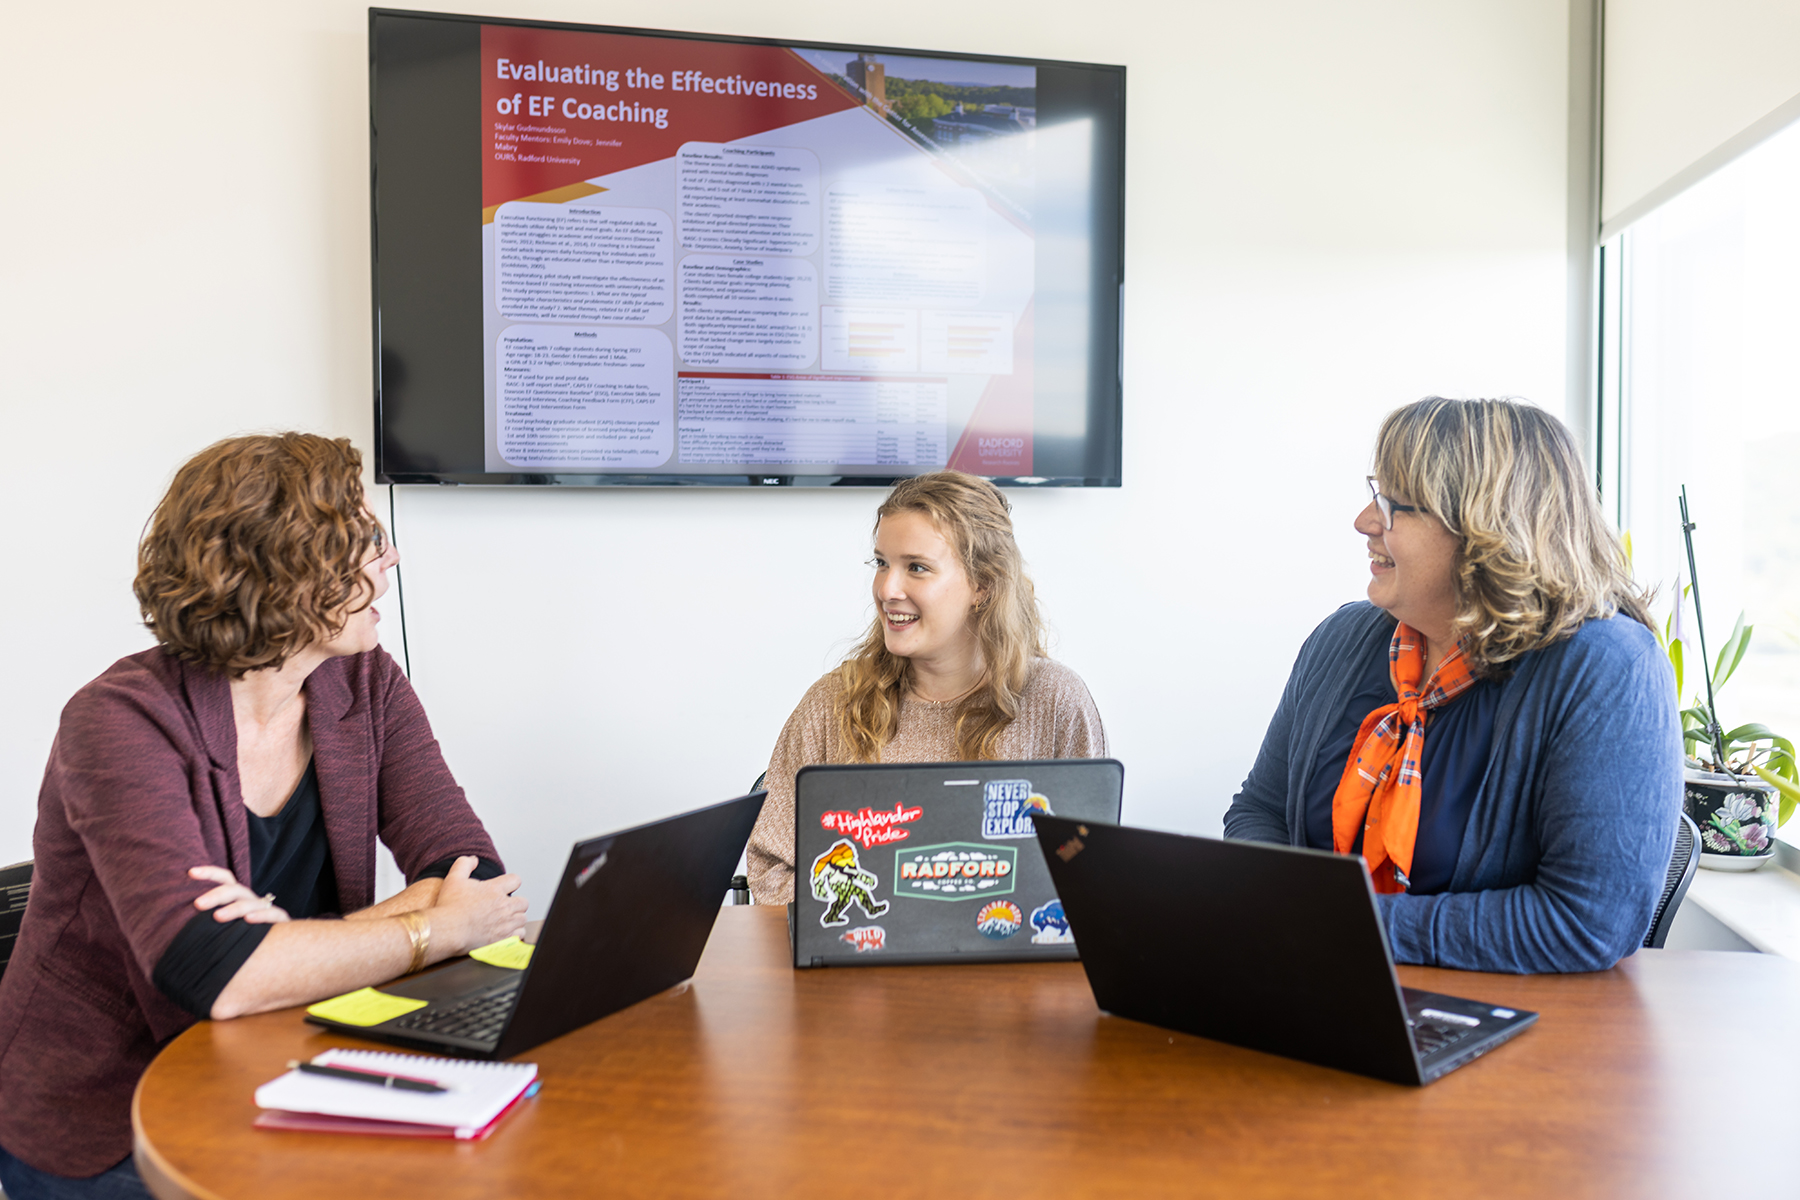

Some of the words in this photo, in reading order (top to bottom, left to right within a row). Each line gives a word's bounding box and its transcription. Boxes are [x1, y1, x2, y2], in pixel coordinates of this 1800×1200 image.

[497, 58, 620, 92] Evaluating
[626, 67, 664, 90] the
[671, 70, 818, 100] Effectiveness
[496, 93, 522, 116] of
[528, 95, 555, 116] EF
[562, 97, 669, 130] Coaching
[858, 86, 872, 99] with
[872, 96, 883, 107] the
[882, 104, 902, 122] Center
[902, 118, 911, 128] for
[494, 122, 515, 132] Skylar
[494, 133, 519, 142] Faculty
[520, 135, 552, 143] Mentors:
[553, 136, 572, 145] Emily
[594, 139, 622, 147] Jennifer
[494, 142, 518, 152] Mabry
[518, 154, 545, 162] Radford
[546, 156, 581, 166] University
[978, 438, 1024, 449] RADFORD
[978, 448, 1024, 457] UNIVERSITY
[988, 783, 1028, 801] NEVER
[988, 800, 1020, 818] STOP
[821, 804, 920, 840] #Highlander
[986, 817, 1036, 835] EXPLOR
[862, 826, 908, 847] Pride
[901, 860, 1012, 880] RADFORD
[977, 900, 1007, 924] EXPLORE
[1008, 902, 1022, 925] MORE
[854, 929, 882, 941] WILD
